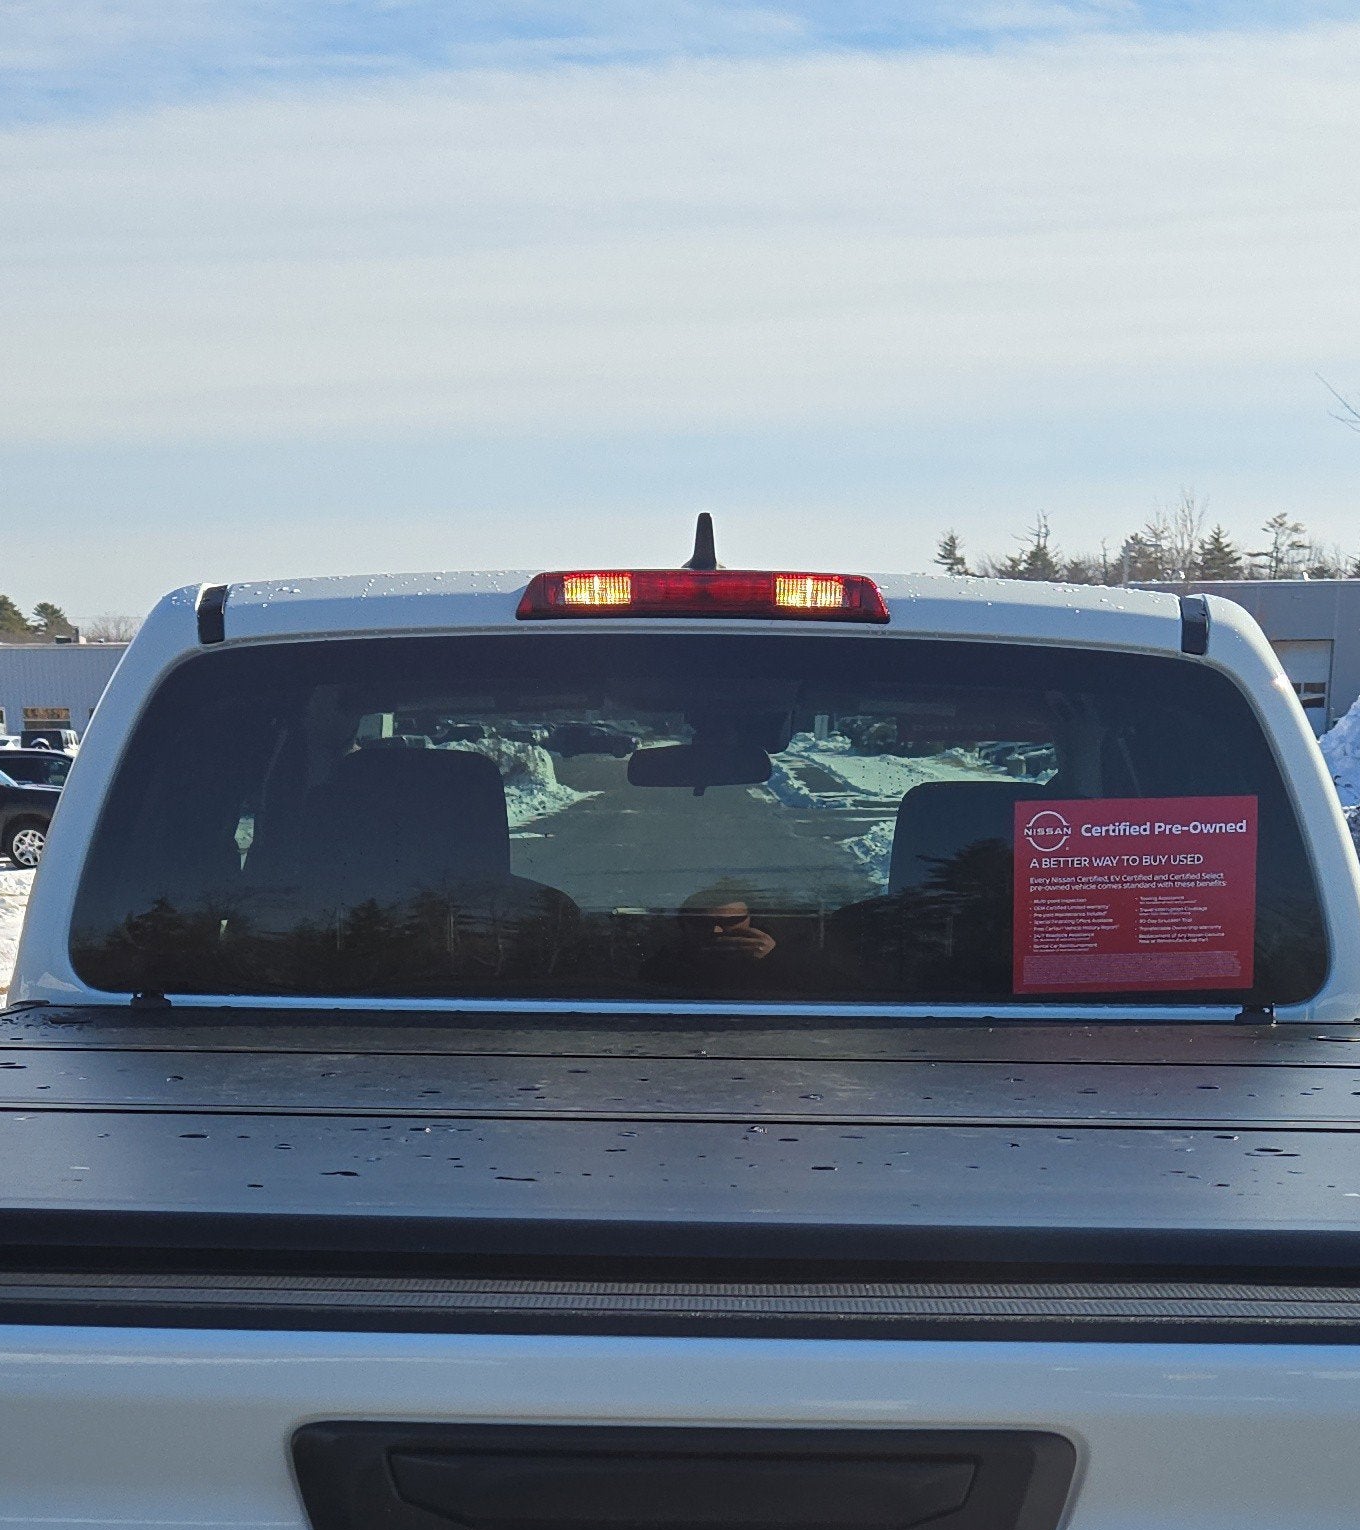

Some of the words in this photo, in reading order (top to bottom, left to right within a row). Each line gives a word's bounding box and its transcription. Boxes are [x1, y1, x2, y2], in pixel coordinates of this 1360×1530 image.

[1024, 827, 1071, 836] NISSAN
[1081, 822, 1151, 837] Certified
[1155, 820, 1247, 835] Pre-Owned
[1029, 858, 1039, 868] A
[1042, 857, 1090, 868] BETTER
[1092, 856, 1119, 867] WAY
[1121, 855, 1139, 866] TO
[1142, 855, 1168, 866] BUY
[1170, 854, 1203, 865] USED
[1029, 877, 1050, 885] Every
[1122, 874, 1153, 882] Certified
[1153, 873, 1168, 881] and
[1169, 873, 1200, 881] Certified
[1201, 872, 1224, 880] Select
[1029, 884, 1070, 892] pre-owned
[1175, 880, 1195, 888] these
